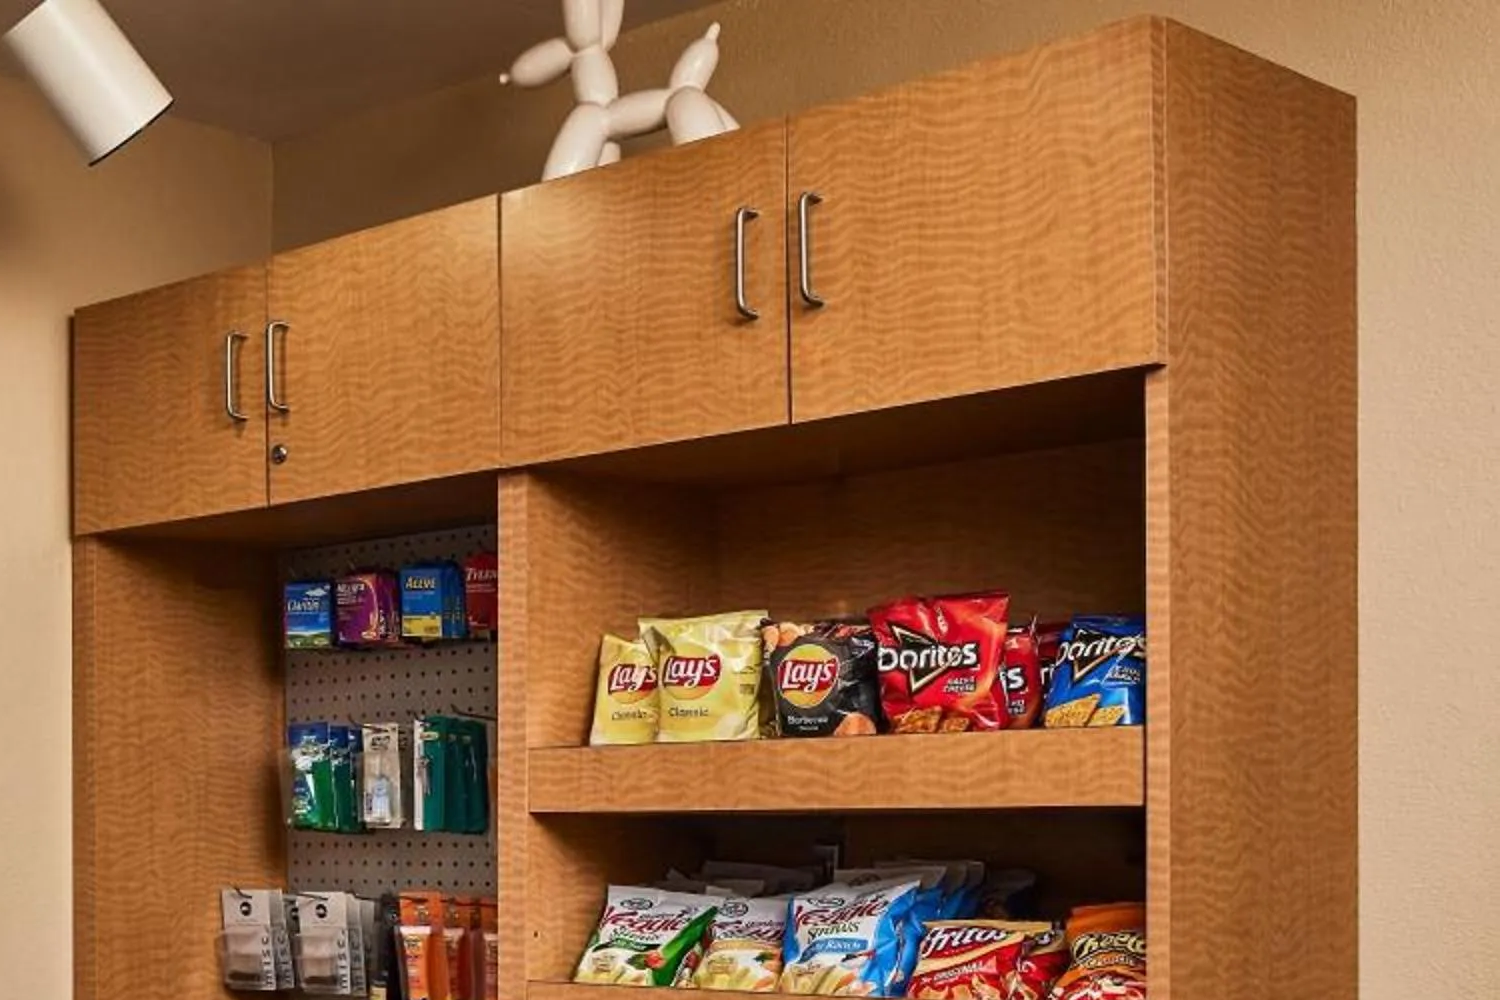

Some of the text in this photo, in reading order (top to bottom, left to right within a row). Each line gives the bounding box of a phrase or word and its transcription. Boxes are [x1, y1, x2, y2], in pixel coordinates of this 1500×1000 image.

[664, 653, 719, 688] Lay's
[877, 642, 980, 672] Doritos
[781, 657, 837, 692] Lay's
[667, 706, 710, 718] Classic
[921, 927, 1008, 958] Fritos
